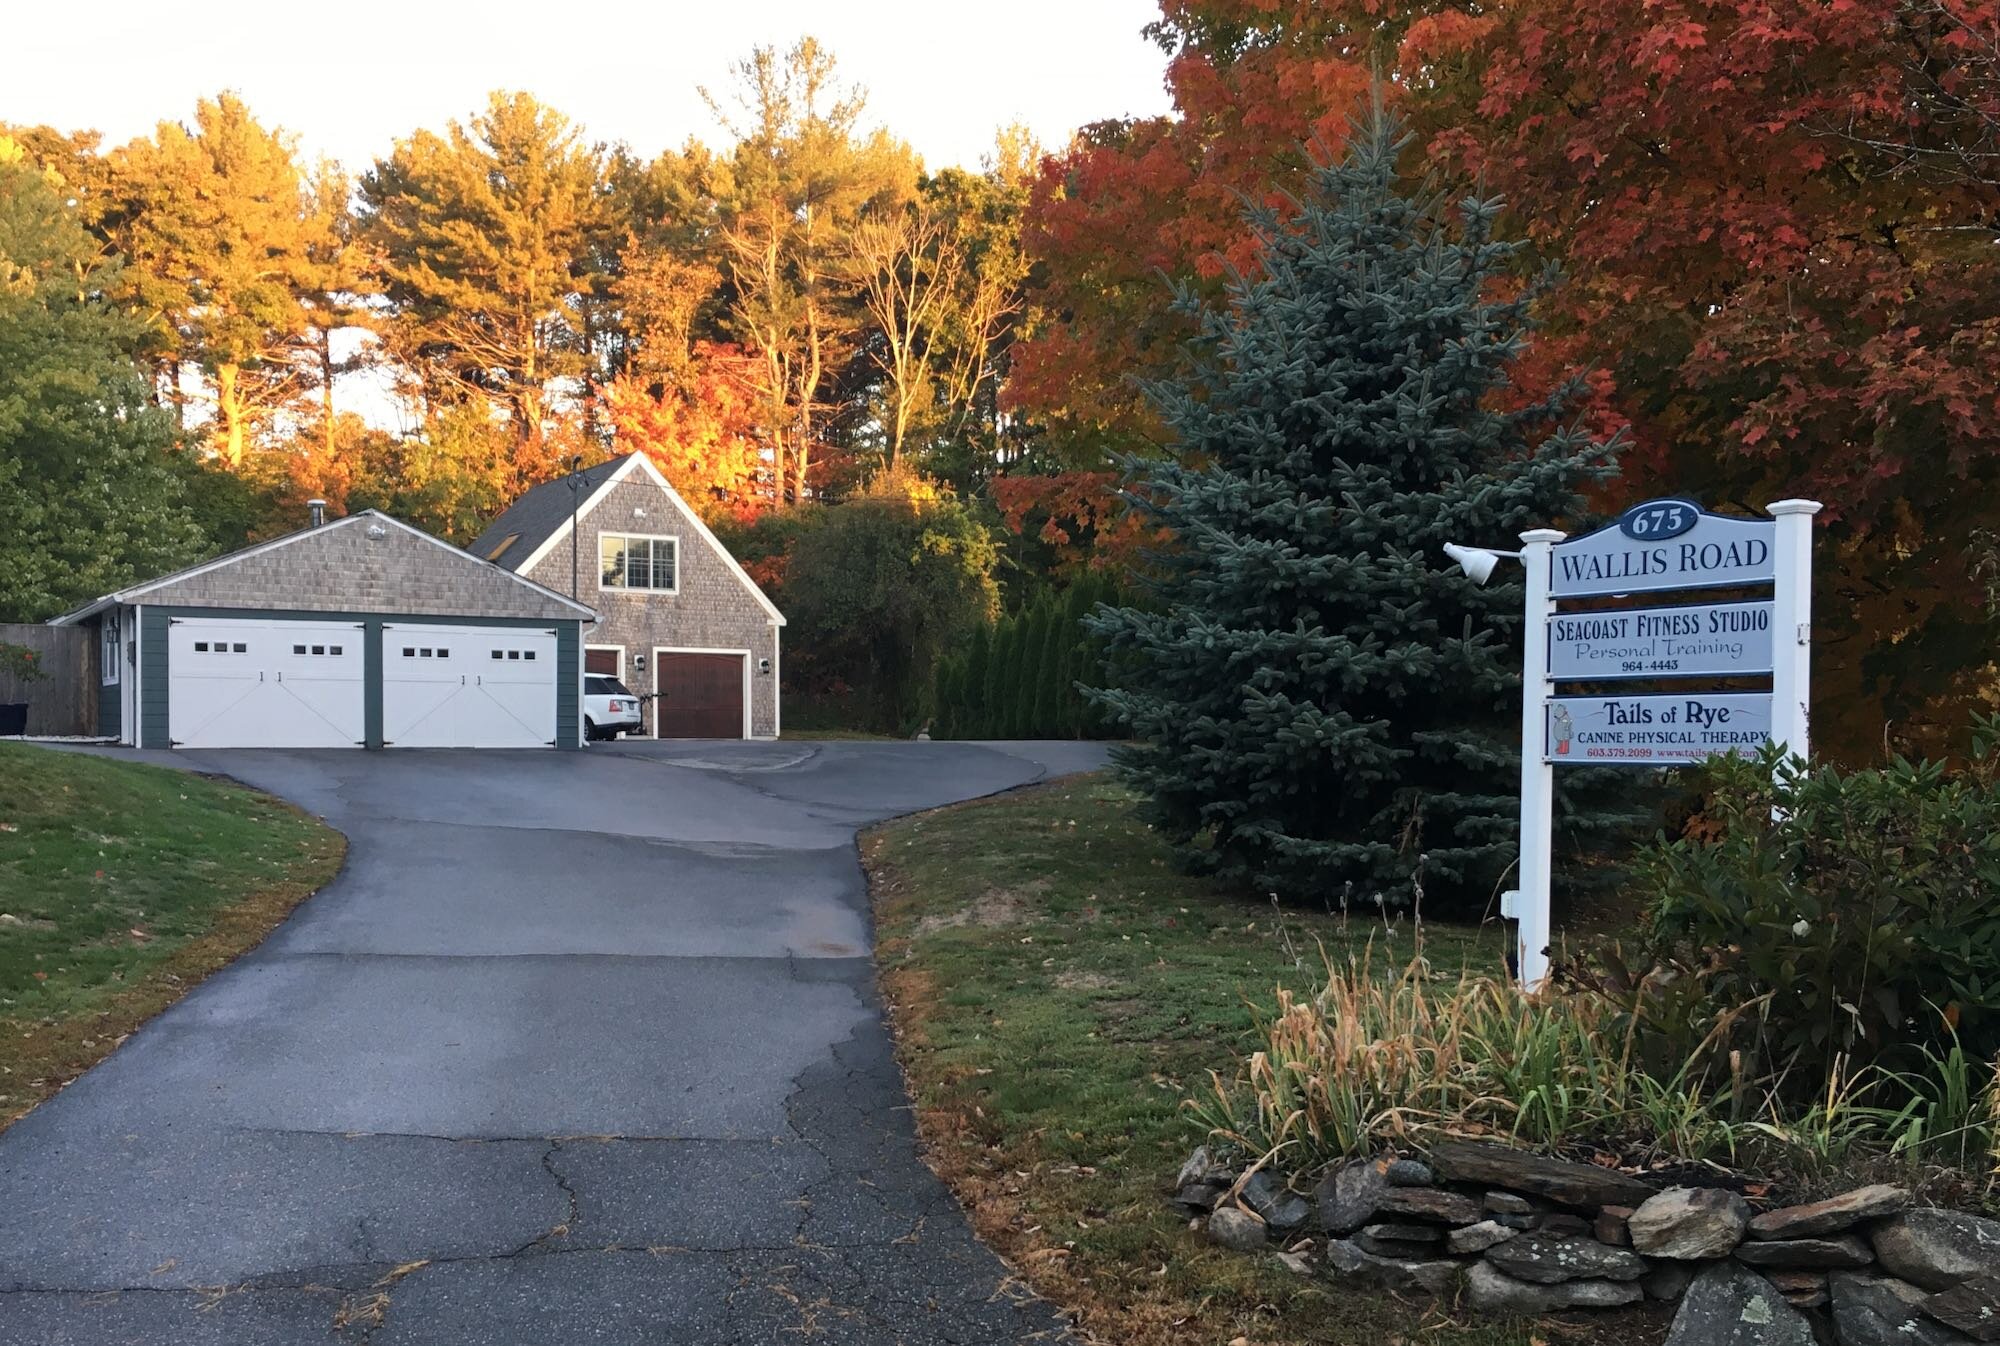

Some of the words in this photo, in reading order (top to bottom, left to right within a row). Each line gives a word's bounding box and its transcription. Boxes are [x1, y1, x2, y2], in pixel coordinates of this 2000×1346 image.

[1632, 507, 1682, 534] 675
[1560, 548, 1667, 582] WALLIS
[1678, 539, 1768, 572] ROAD
[1557, 618, 1628, 641] SEACOAST
[1637, 613, 1700, 637] FITNESS
[1709, 609, 1768, 634] STUDIO
[1575, 640, 1655, 659] Personal
[1662, 639, 1743, 659] Training
[1603, 701, 1652, 725] Tails
[1660, 707, 1677, 723] of
[1685, 701, 1730, 728] Rye
[1577, 731, 1624, 743] CANINE
[1628, 731, 1695, 743] PHYSICAL
[1700, 731, 1770, 743] THERAPY
[1587, 748, 1652, 757] 603.379.2099
